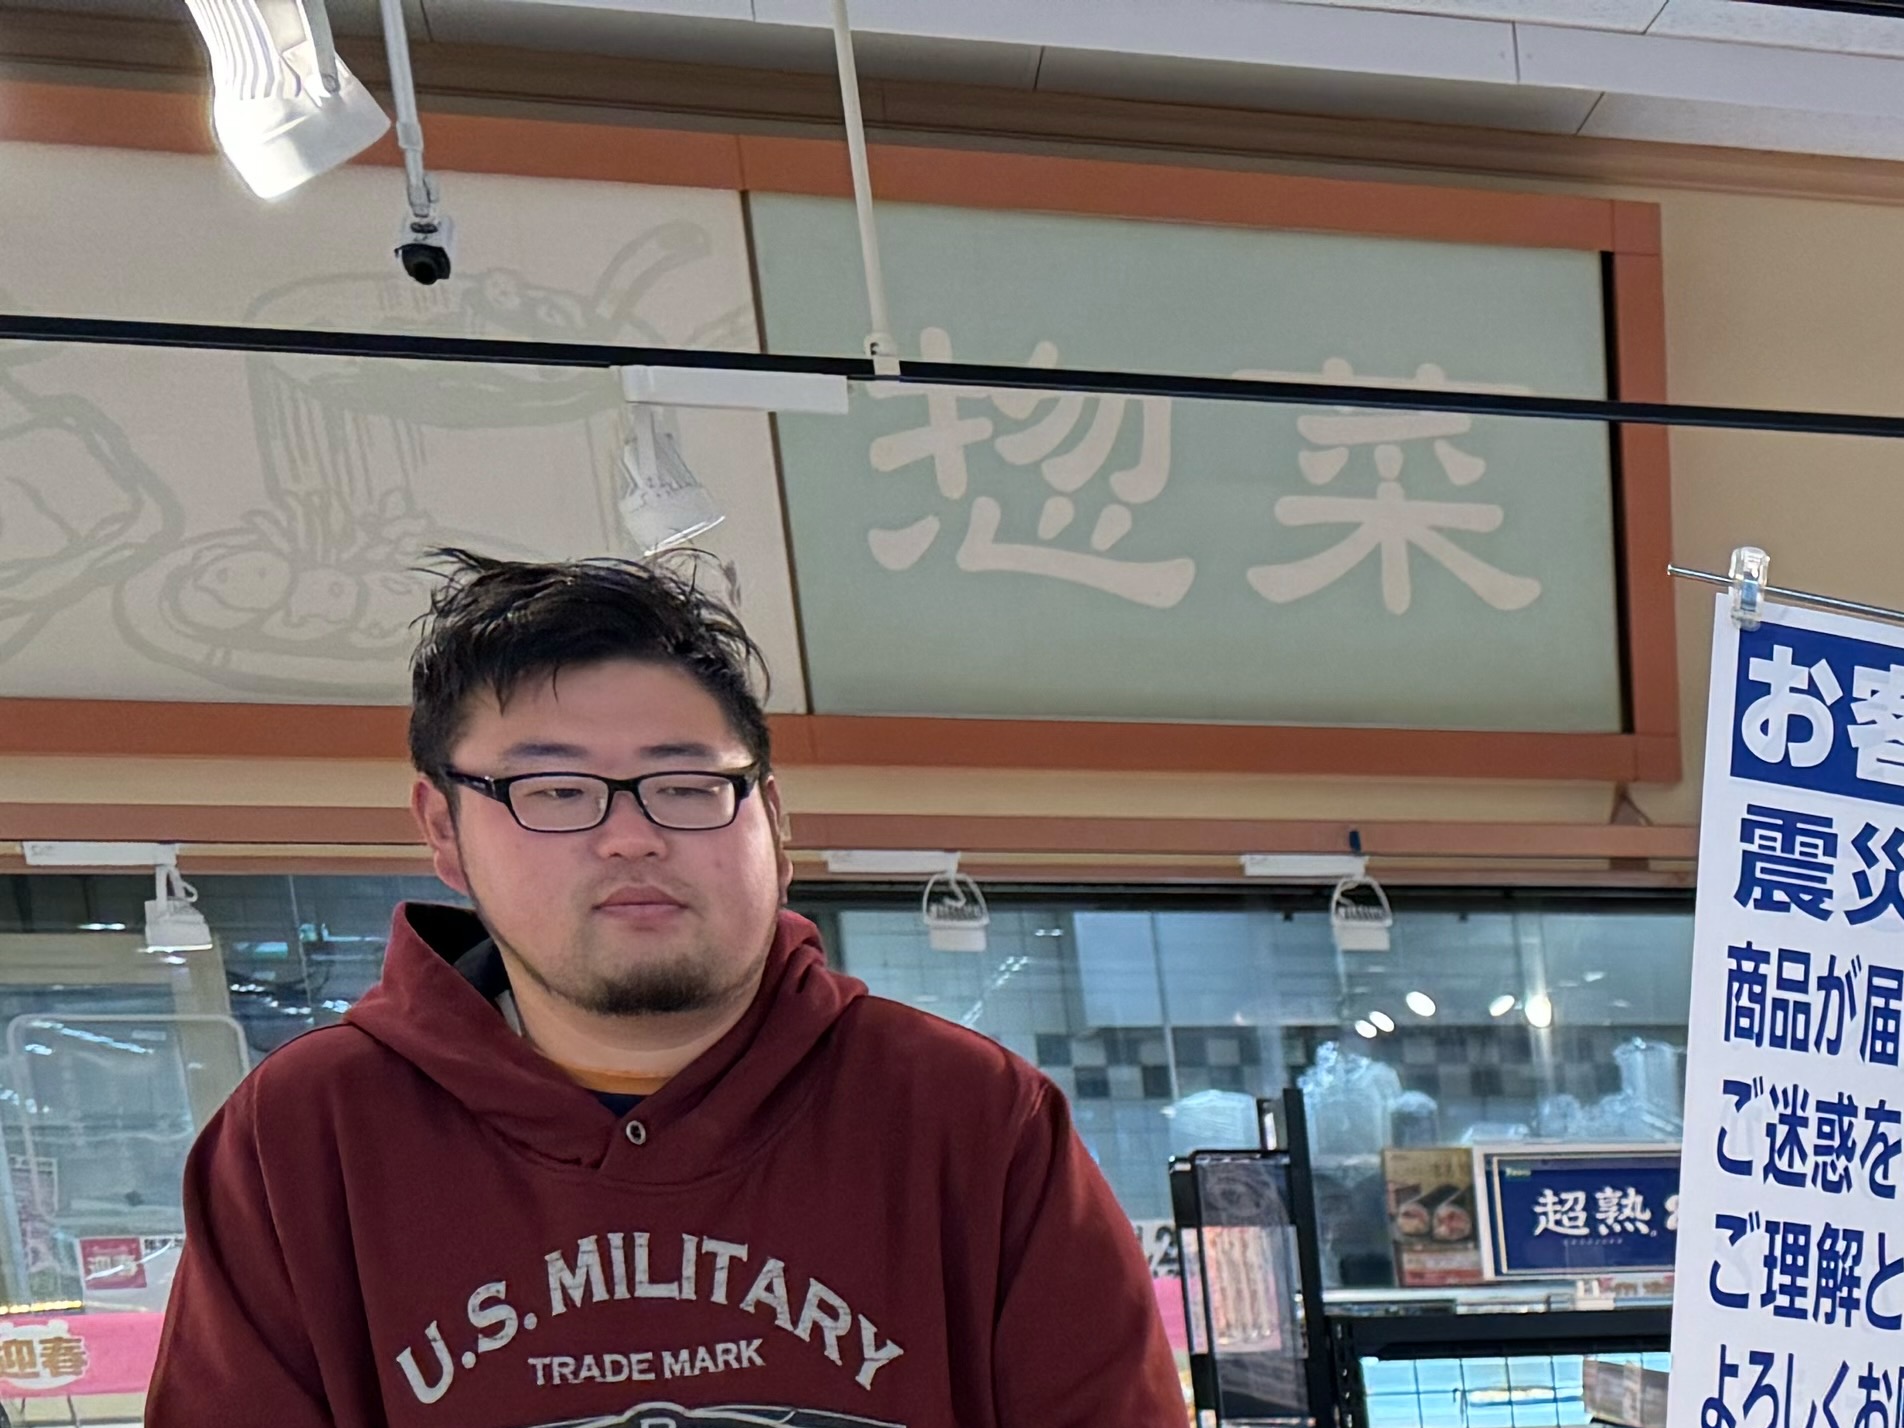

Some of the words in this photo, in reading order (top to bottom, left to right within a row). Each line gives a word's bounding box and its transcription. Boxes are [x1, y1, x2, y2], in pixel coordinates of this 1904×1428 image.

[866, 327, 1541, 615] 惣菜
[1534, 1187, 1652, 1236] 超熟
[397, 1280, 539, 1403] U.S.
[546, 1231, 904, 1389] MILITARY
[528, 1348, 656, 1389] TRADE
[662, 1339, 766, 1378] MARK
